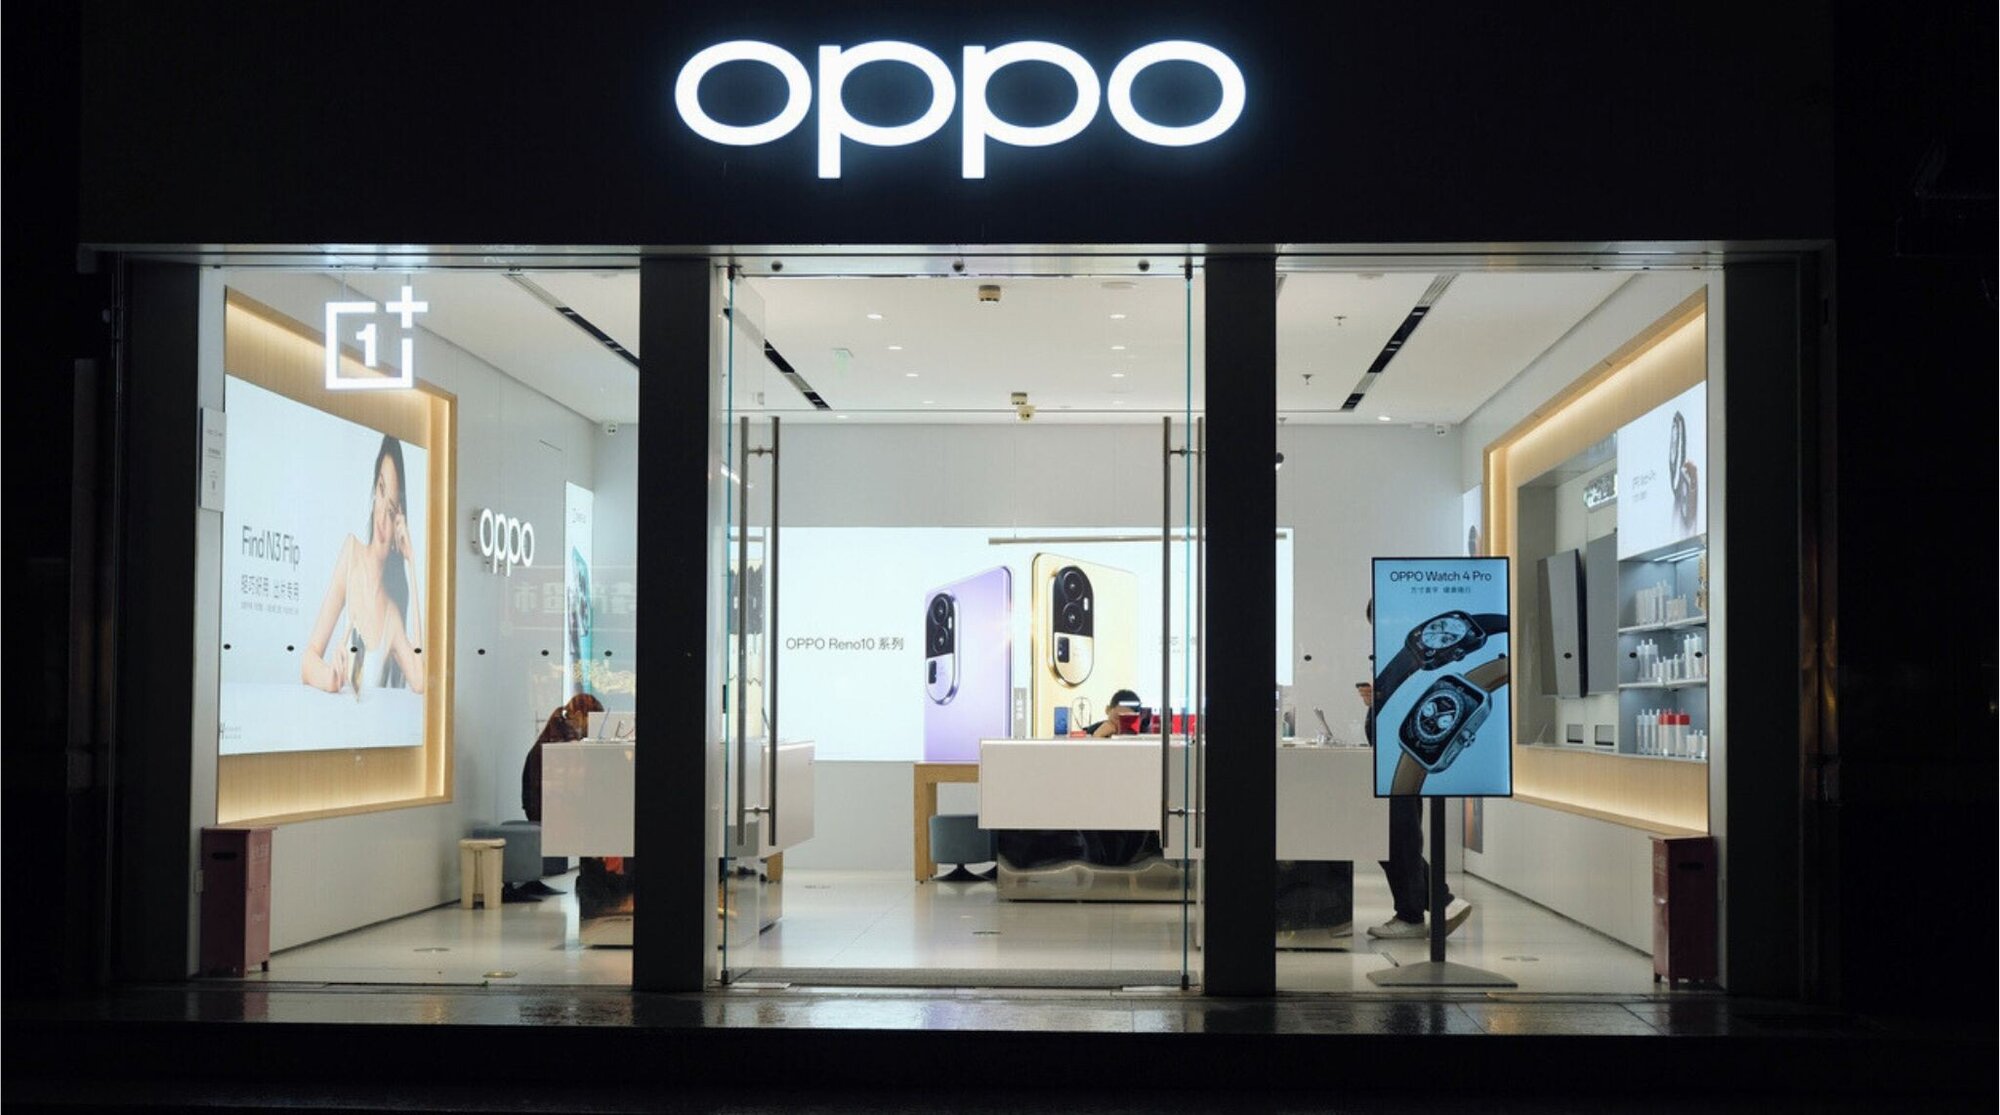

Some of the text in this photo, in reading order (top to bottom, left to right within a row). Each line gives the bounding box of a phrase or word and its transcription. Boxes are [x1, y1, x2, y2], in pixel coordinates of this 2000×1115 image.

[242, 525, 300, 572] Find N3 Flip
[1390, 570, 1492, 582] OPPO Watch 4 Pro
[786, 637, 904, 650] OPPO Reno10 系列
